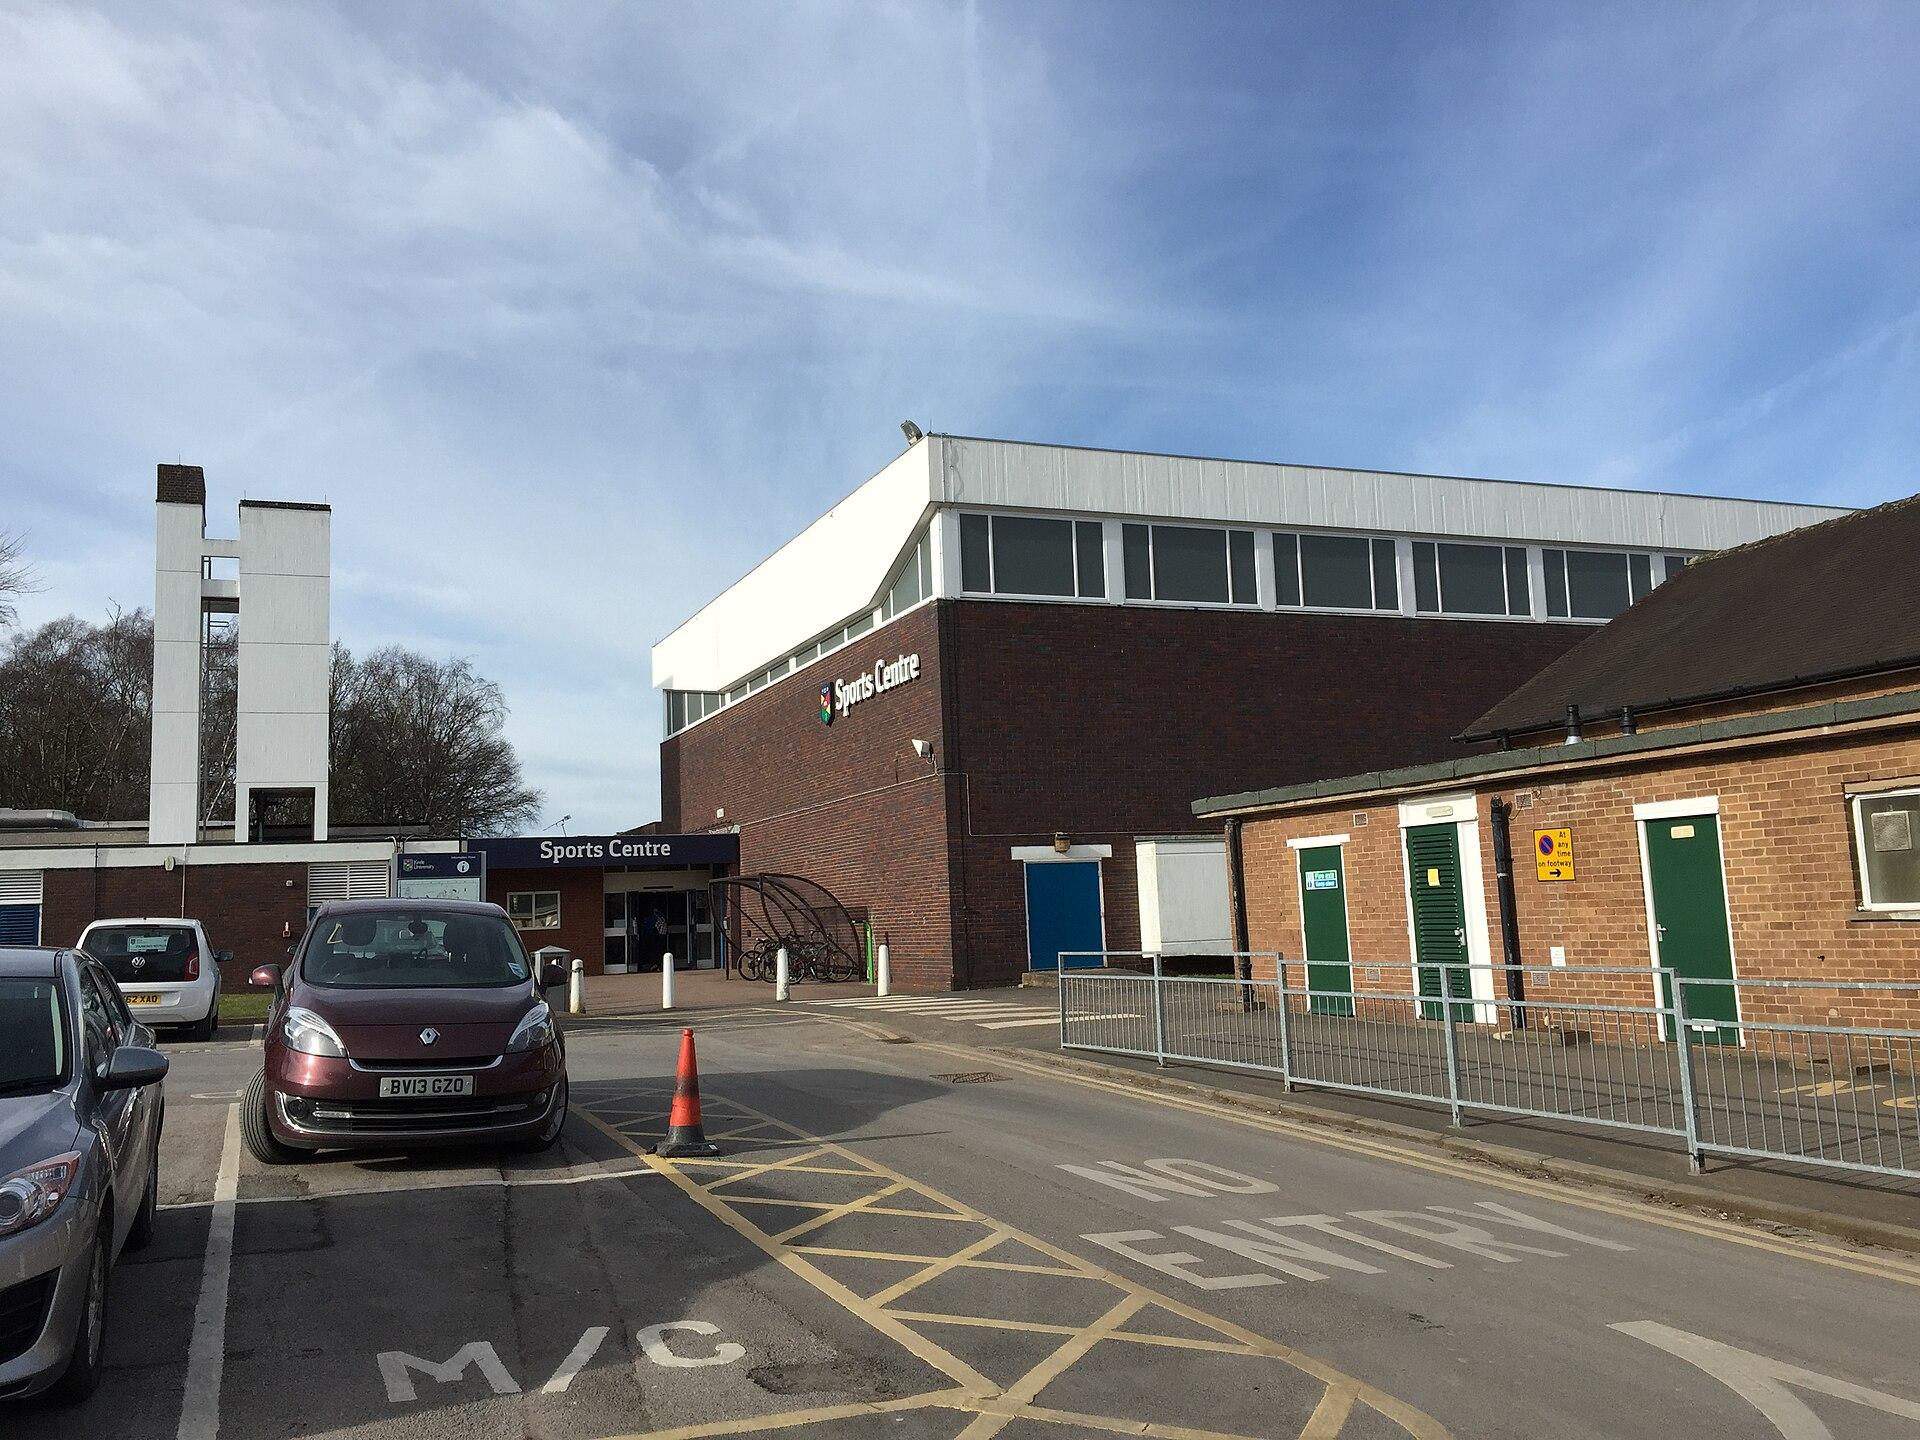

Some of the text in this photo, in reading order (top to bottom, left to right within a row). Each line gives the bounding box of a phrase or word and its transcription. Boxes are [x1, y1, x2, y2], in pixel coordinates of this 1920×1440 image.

[835, 653, 921, 717] Sports Centre
[540, 840, 671, 864] Sports Centre
[390, 1078, 464, 1095] BV13 GZO
[1054, 1157, 1280, 1202] NO
[1078, 1201, 1637, 1291] ENTRY
